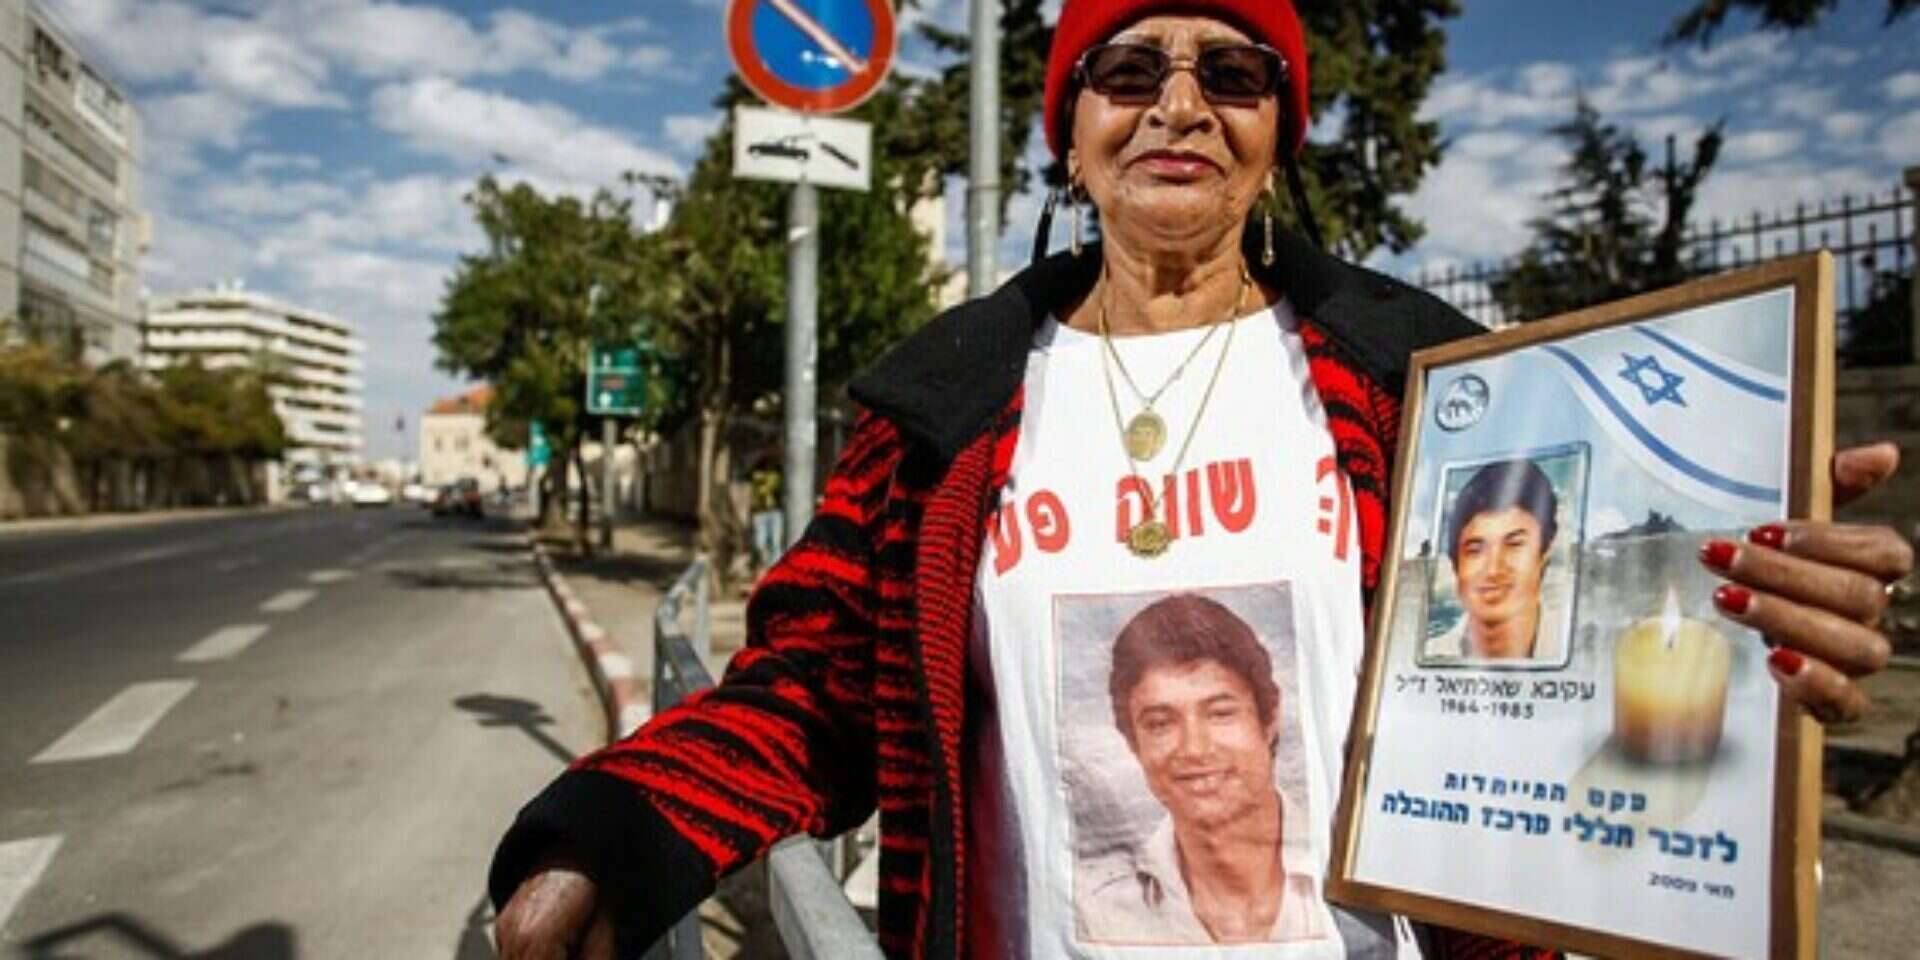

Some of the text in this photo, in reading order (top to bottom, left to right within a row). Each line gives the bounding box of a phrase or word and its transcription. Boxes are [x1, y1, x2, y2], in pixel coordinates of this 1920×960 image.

[1115, 457, 1257, 543] שווה
[1435, 675, 1523, 699] שאלתיאל
[1531, 679, 1596, 703] עקיבא
[1444, 772, 1567, 802] התייחדות
[1381, 789, 1738, 864] לזכר חללי מרכז ההובלה
